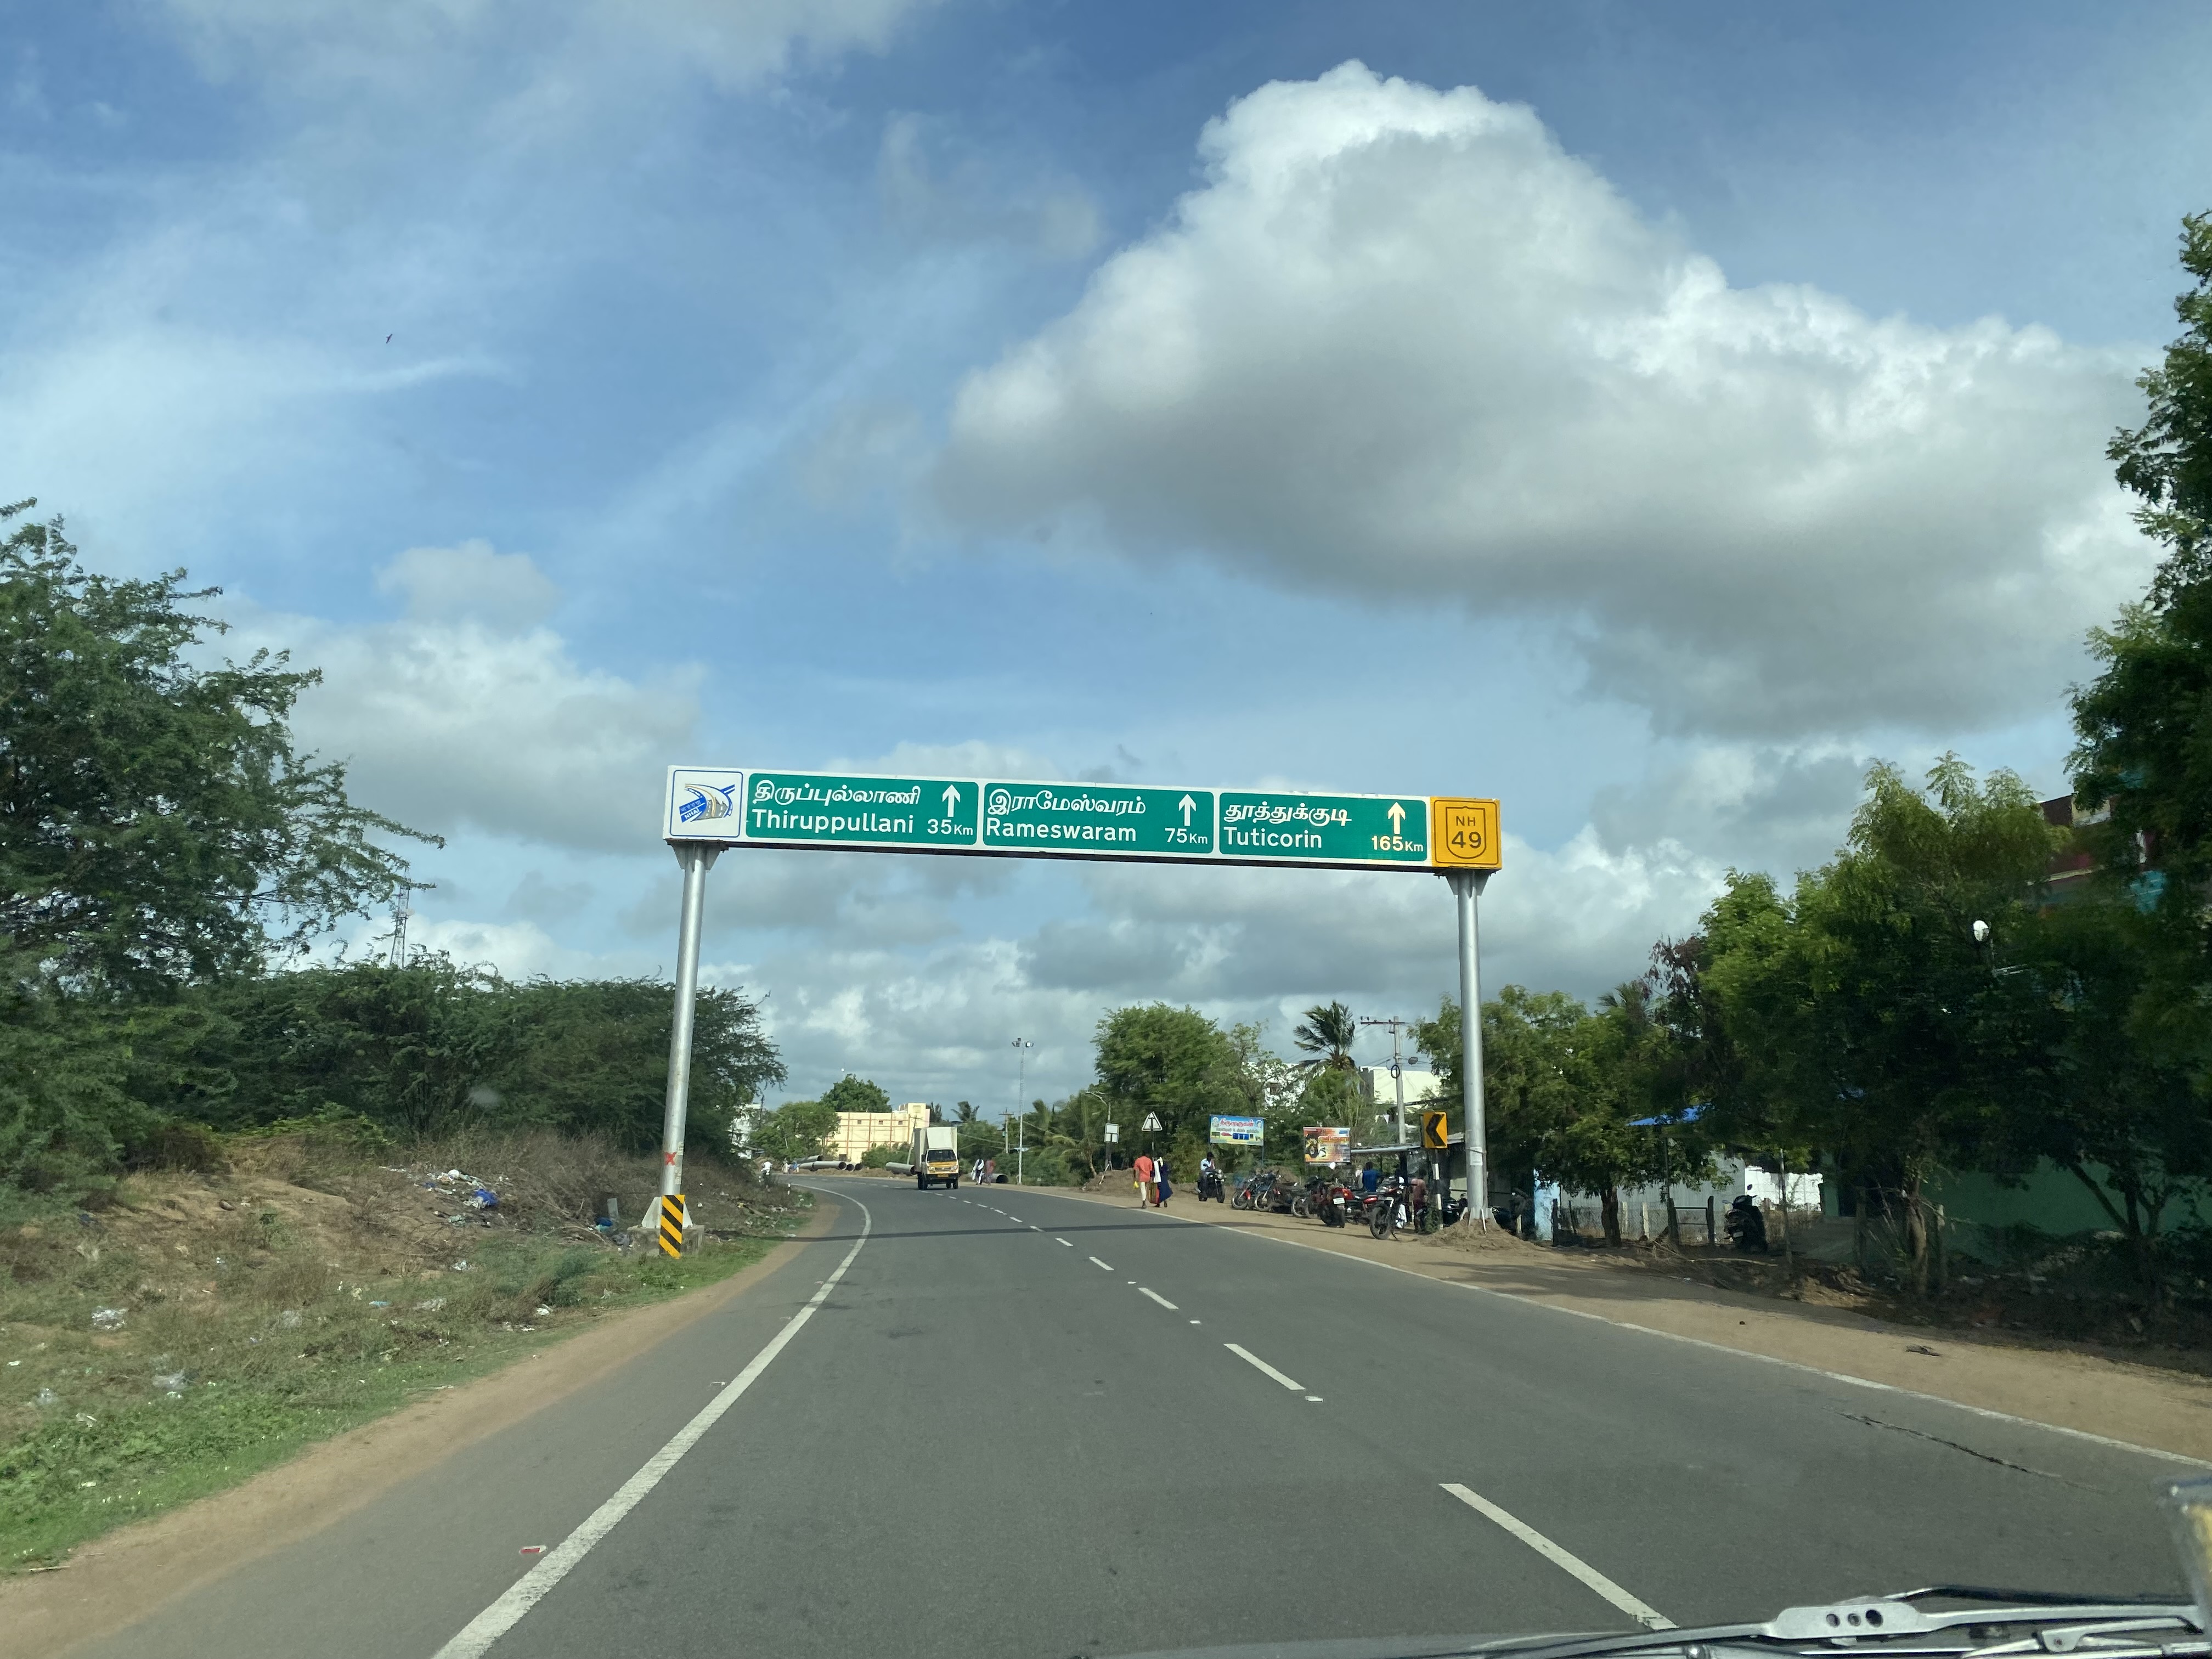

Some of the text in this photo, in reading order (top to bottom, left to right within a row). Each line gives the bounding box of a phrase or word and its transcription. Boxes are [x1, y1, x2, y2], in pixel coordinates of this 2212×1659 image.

[752, 780, 921, 806] திருப்புல்லாணி
[988, 788, 1146, 816] இராமேஸ்வரம்
[684, 808, 700, 819] NHAI
[752, 809, 913, 834] Thiruppullani
[1223, 801, 1352, 827] தூத்துக்குடி
[1456, 816, 1476, 827] NH
[986, 817, 1136, 842] Rameswaram
[1223, 826, 1322, 848] Tuticorin
[1451, 831, 1482, 849] 49
